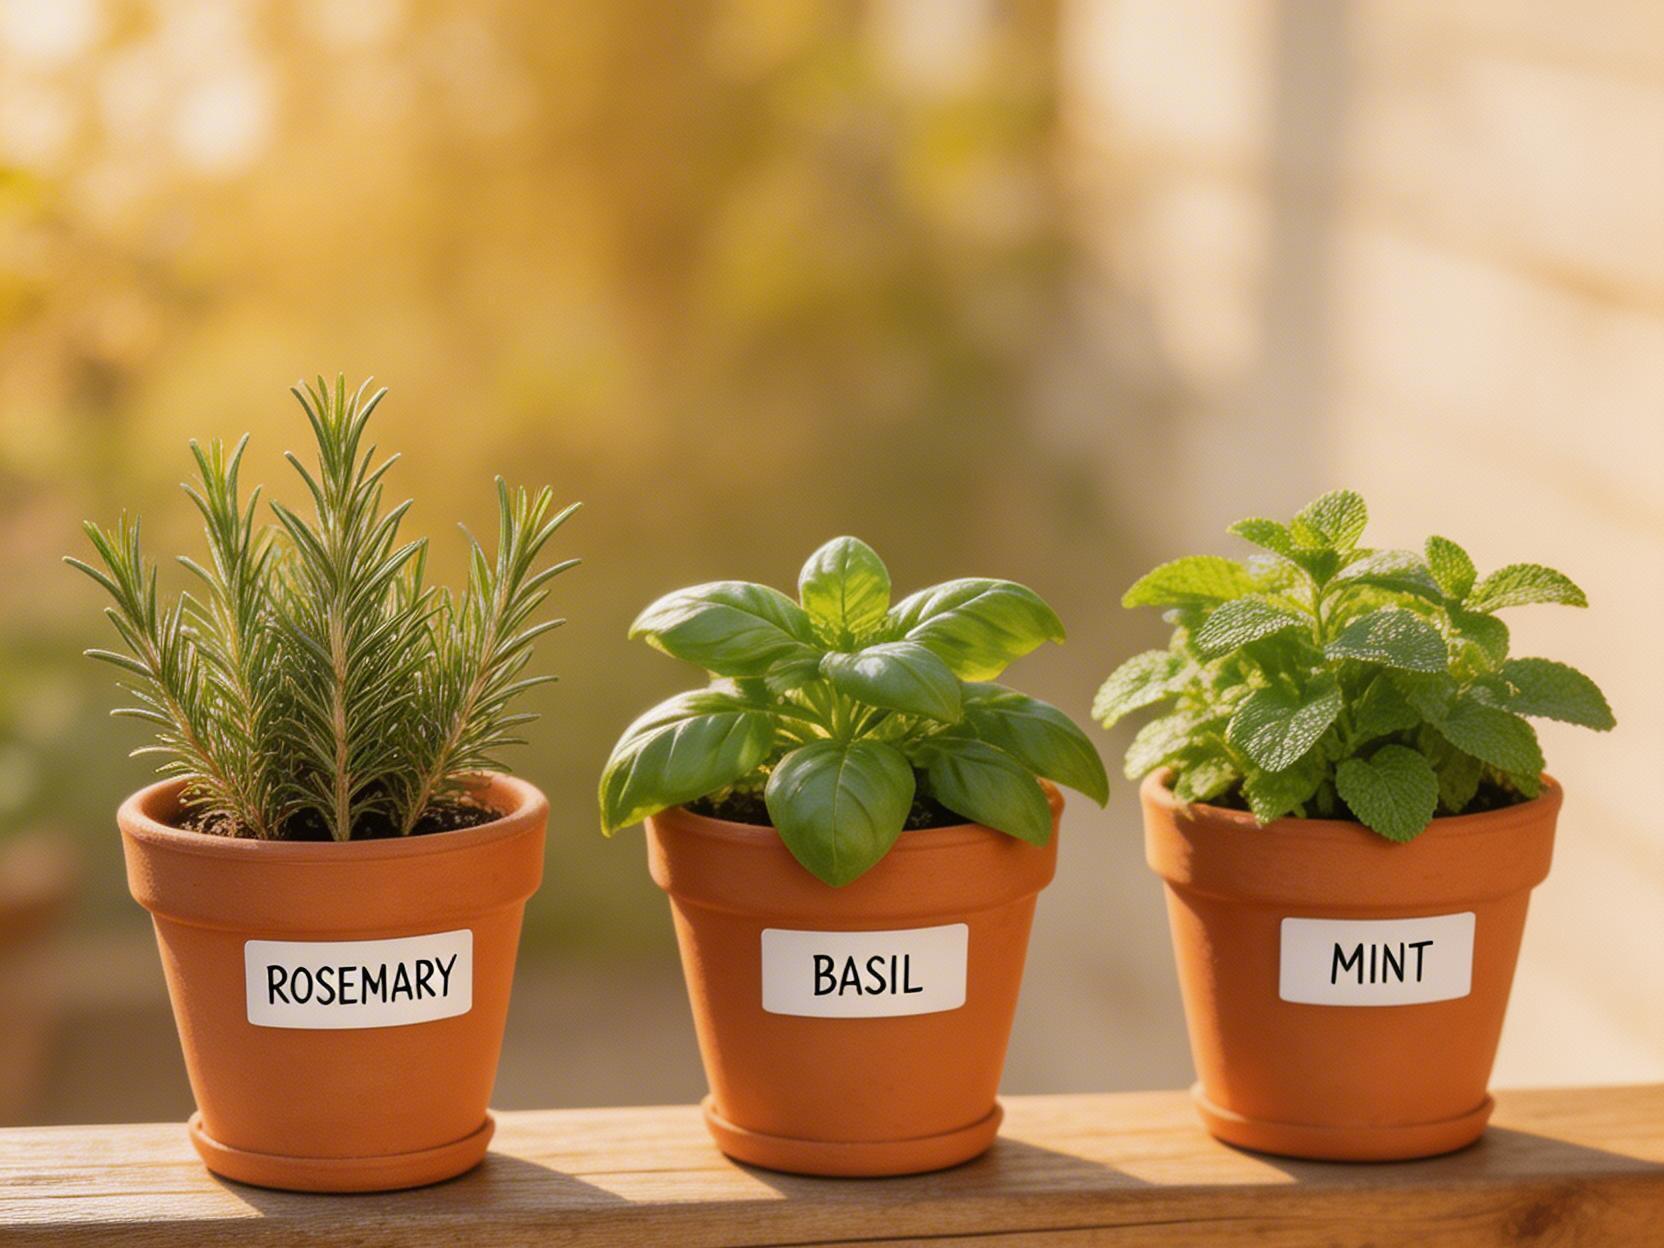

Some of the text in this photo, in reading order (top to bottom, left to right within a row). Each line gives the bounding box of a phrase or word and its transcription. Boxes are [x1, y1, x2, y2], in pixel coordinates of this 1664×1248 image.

[266, 953, 458, 1005] ROSEMARY
[812, 953, 924, 997] BASIL
[1330, 940, 1434, 985] MINT
